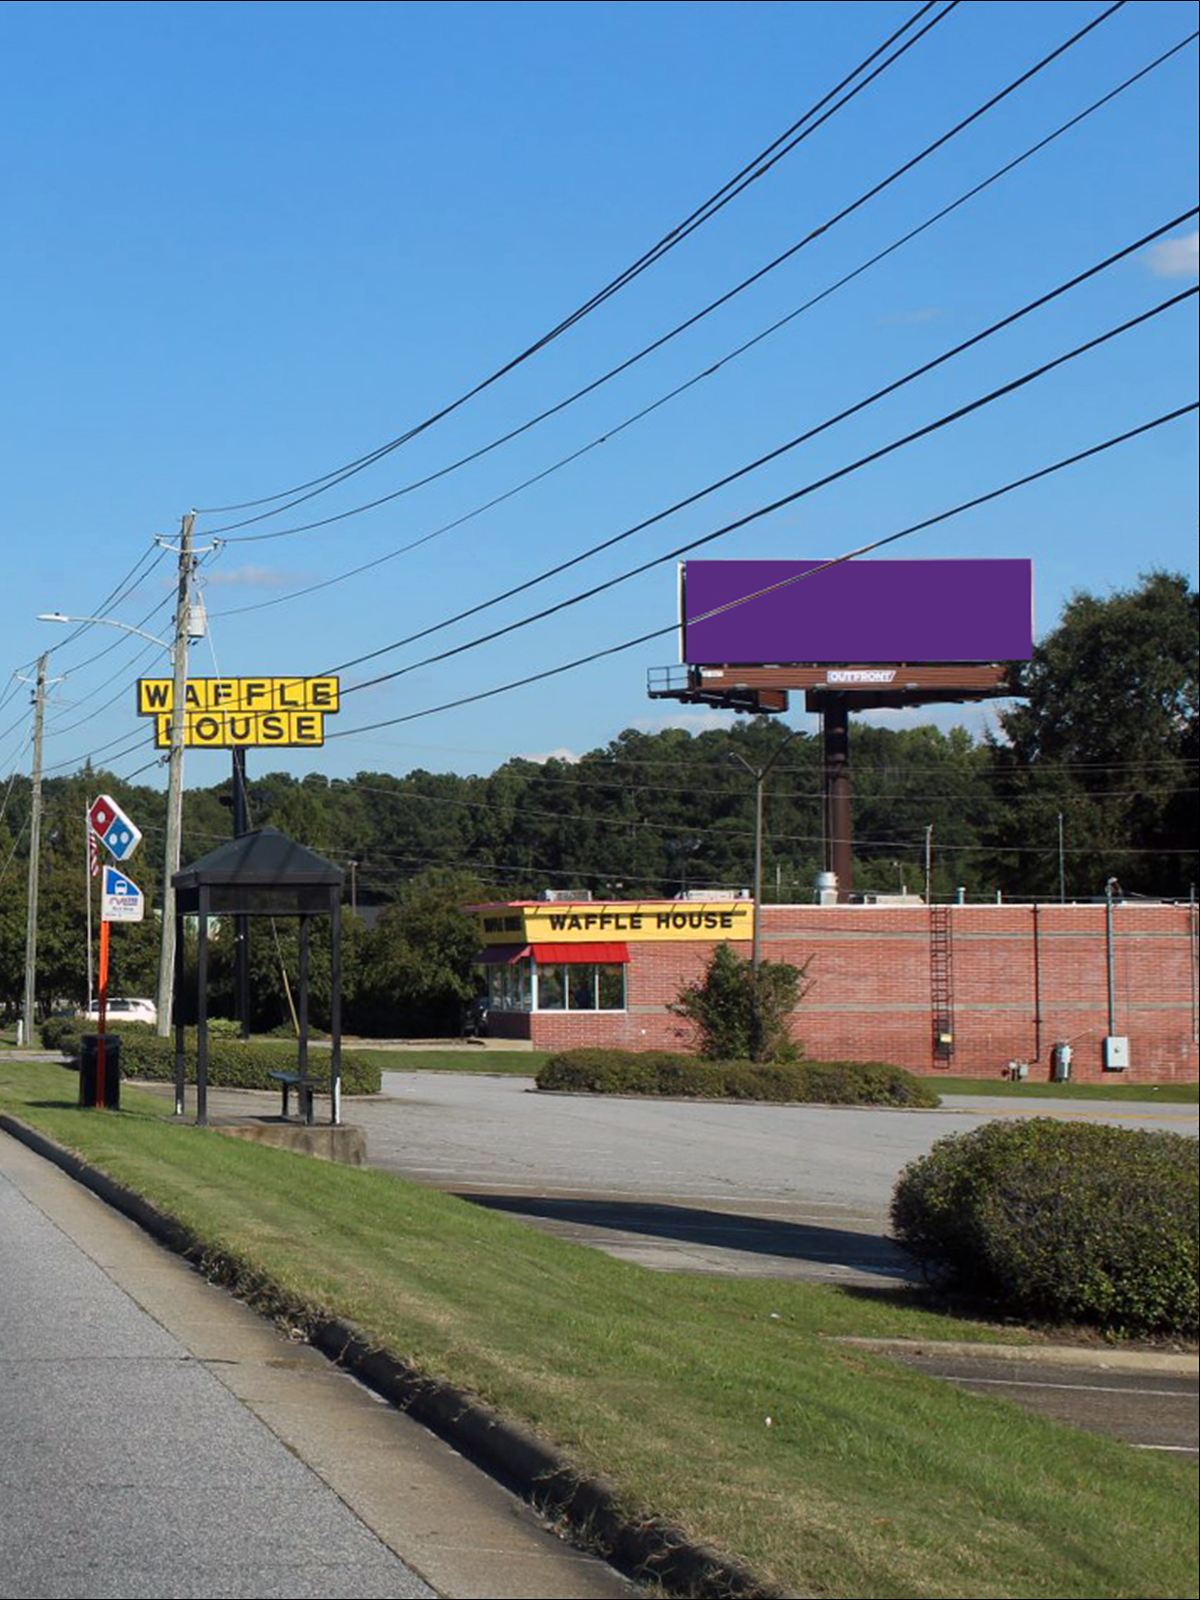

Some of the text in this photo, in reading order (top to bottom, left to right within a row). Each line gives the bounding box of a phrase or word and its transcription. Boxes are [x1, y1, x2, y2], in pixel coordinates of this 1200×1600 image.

[829, 671, 893, 682] OUTFRONT
[145, 682, 332, 708] WAFFLE
[549, 911, 733, 931] WAFFLE HOUSE
